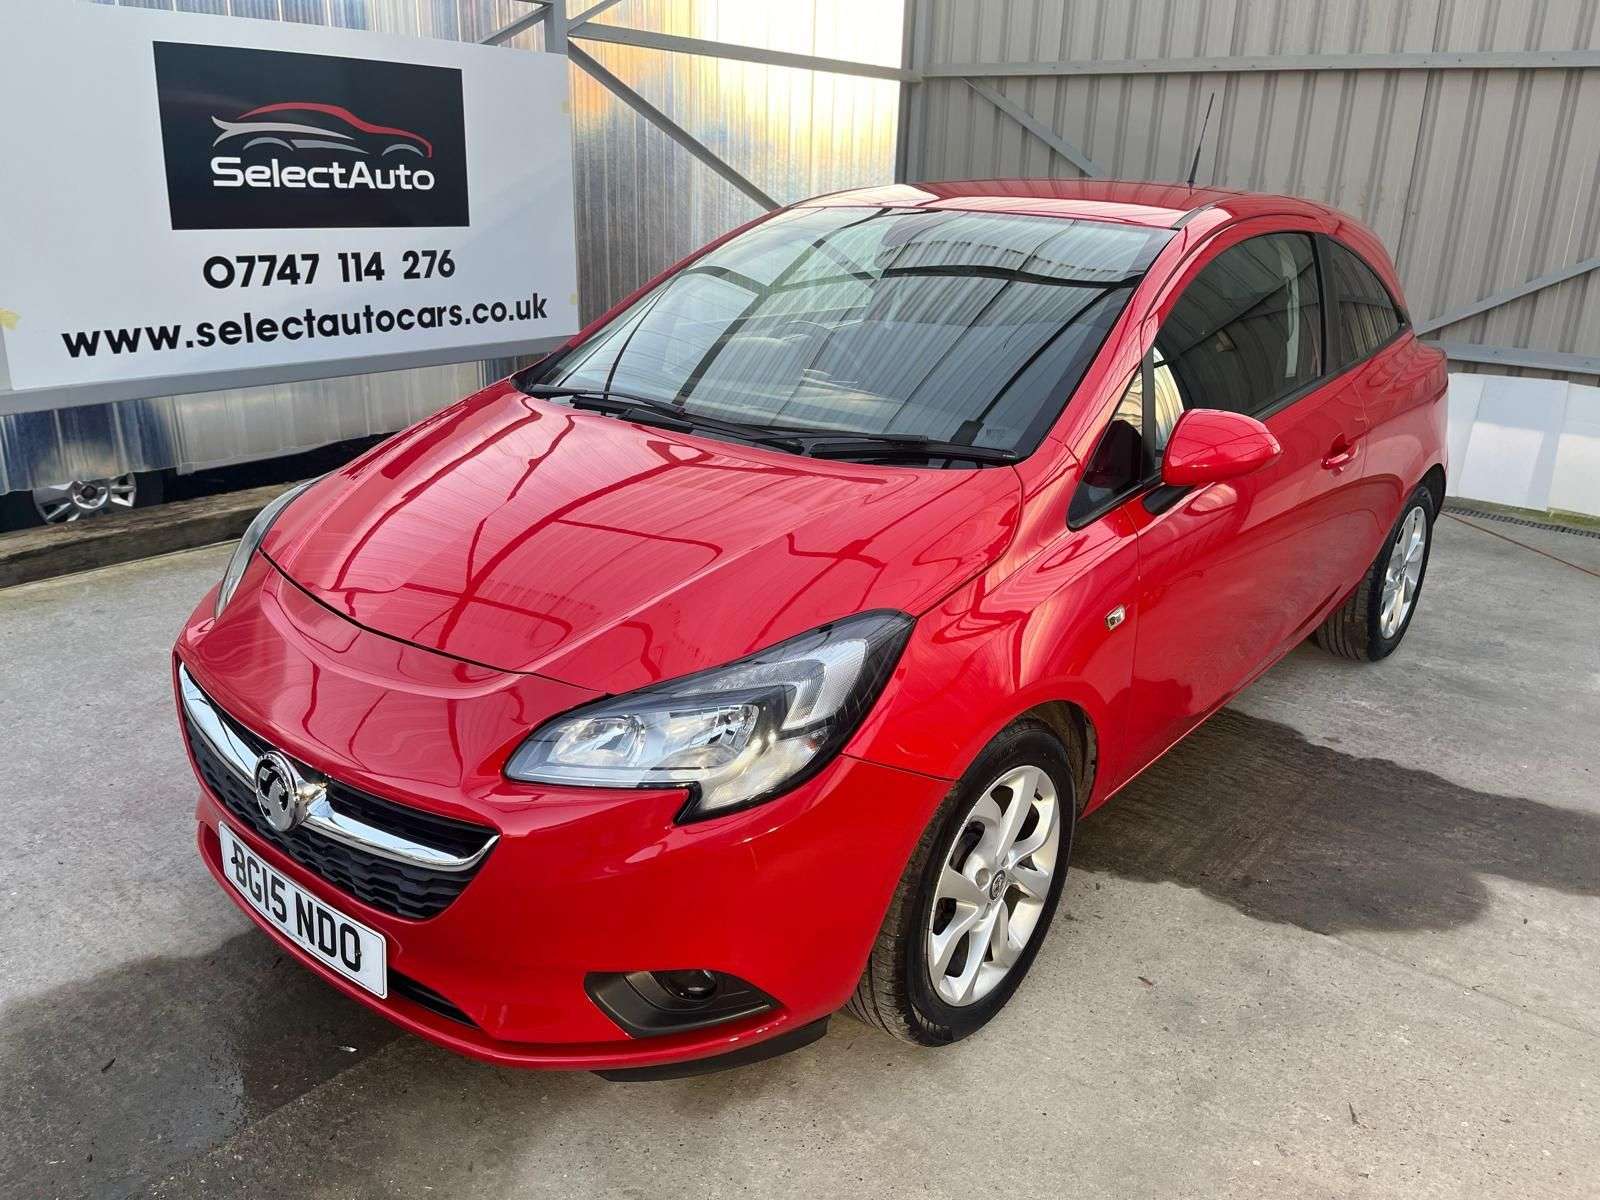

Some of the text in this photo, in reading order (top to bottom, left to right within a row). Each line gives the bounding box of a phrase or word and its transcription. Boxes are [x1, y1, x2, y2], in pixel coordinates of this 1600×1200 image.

[211, 157, 434, 189] SelectAuto
[203, 250, 456, 289] 07747 114 276
[62, 293, 548, 357] www.selectautocars.co.uk
[233, 841, 361, 973] BG15 NDO
